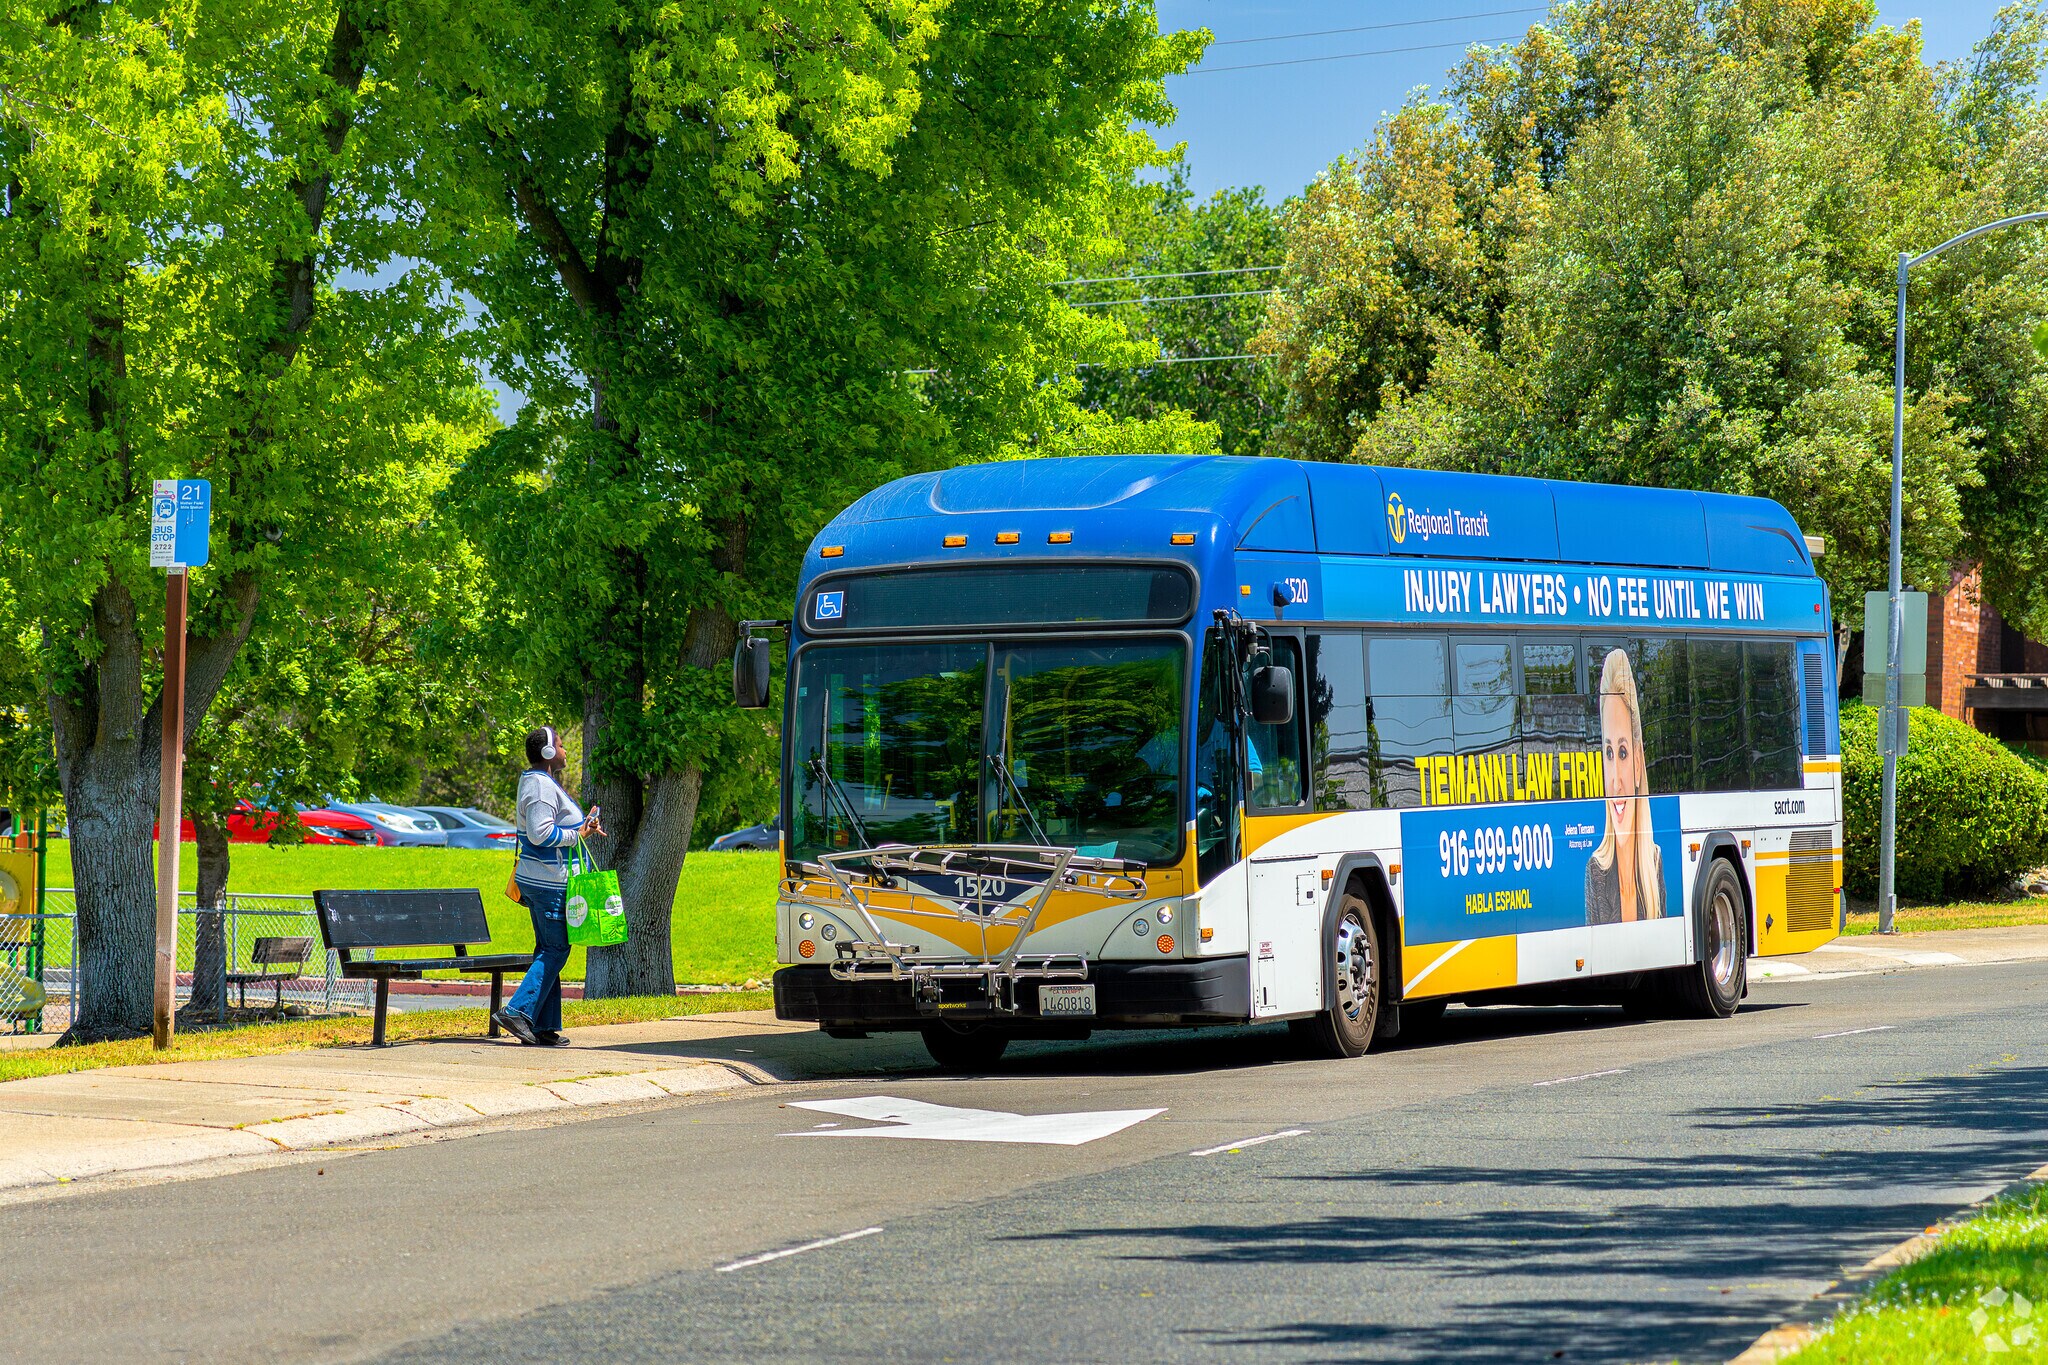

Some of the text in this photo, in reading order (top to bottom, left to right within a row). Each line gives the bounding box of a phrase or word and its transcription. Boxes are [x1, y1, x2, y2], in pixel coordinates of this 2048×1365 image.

[182, 485, 200, 500] 21
[1407, 508, 1490, 541] Regional Transit
[1404, 570, 1764, 620] INJURY LAWYERS NO FEE UNTIL WE WIN
[1414, 751, 1604, 806] TIEMANN LAW FIRM
[1774, 798, 1805, 814] sacrt.com
[1578, 824, 1595, 834] Tiemann
[1439, 823, 1553, 878] 916-999-9000
[954, 876, 1006, 897] 1520
[1466, 889, 1532, 914] HABLA ESPANOL
[1044, 996, 1090, 1010] 1460818
